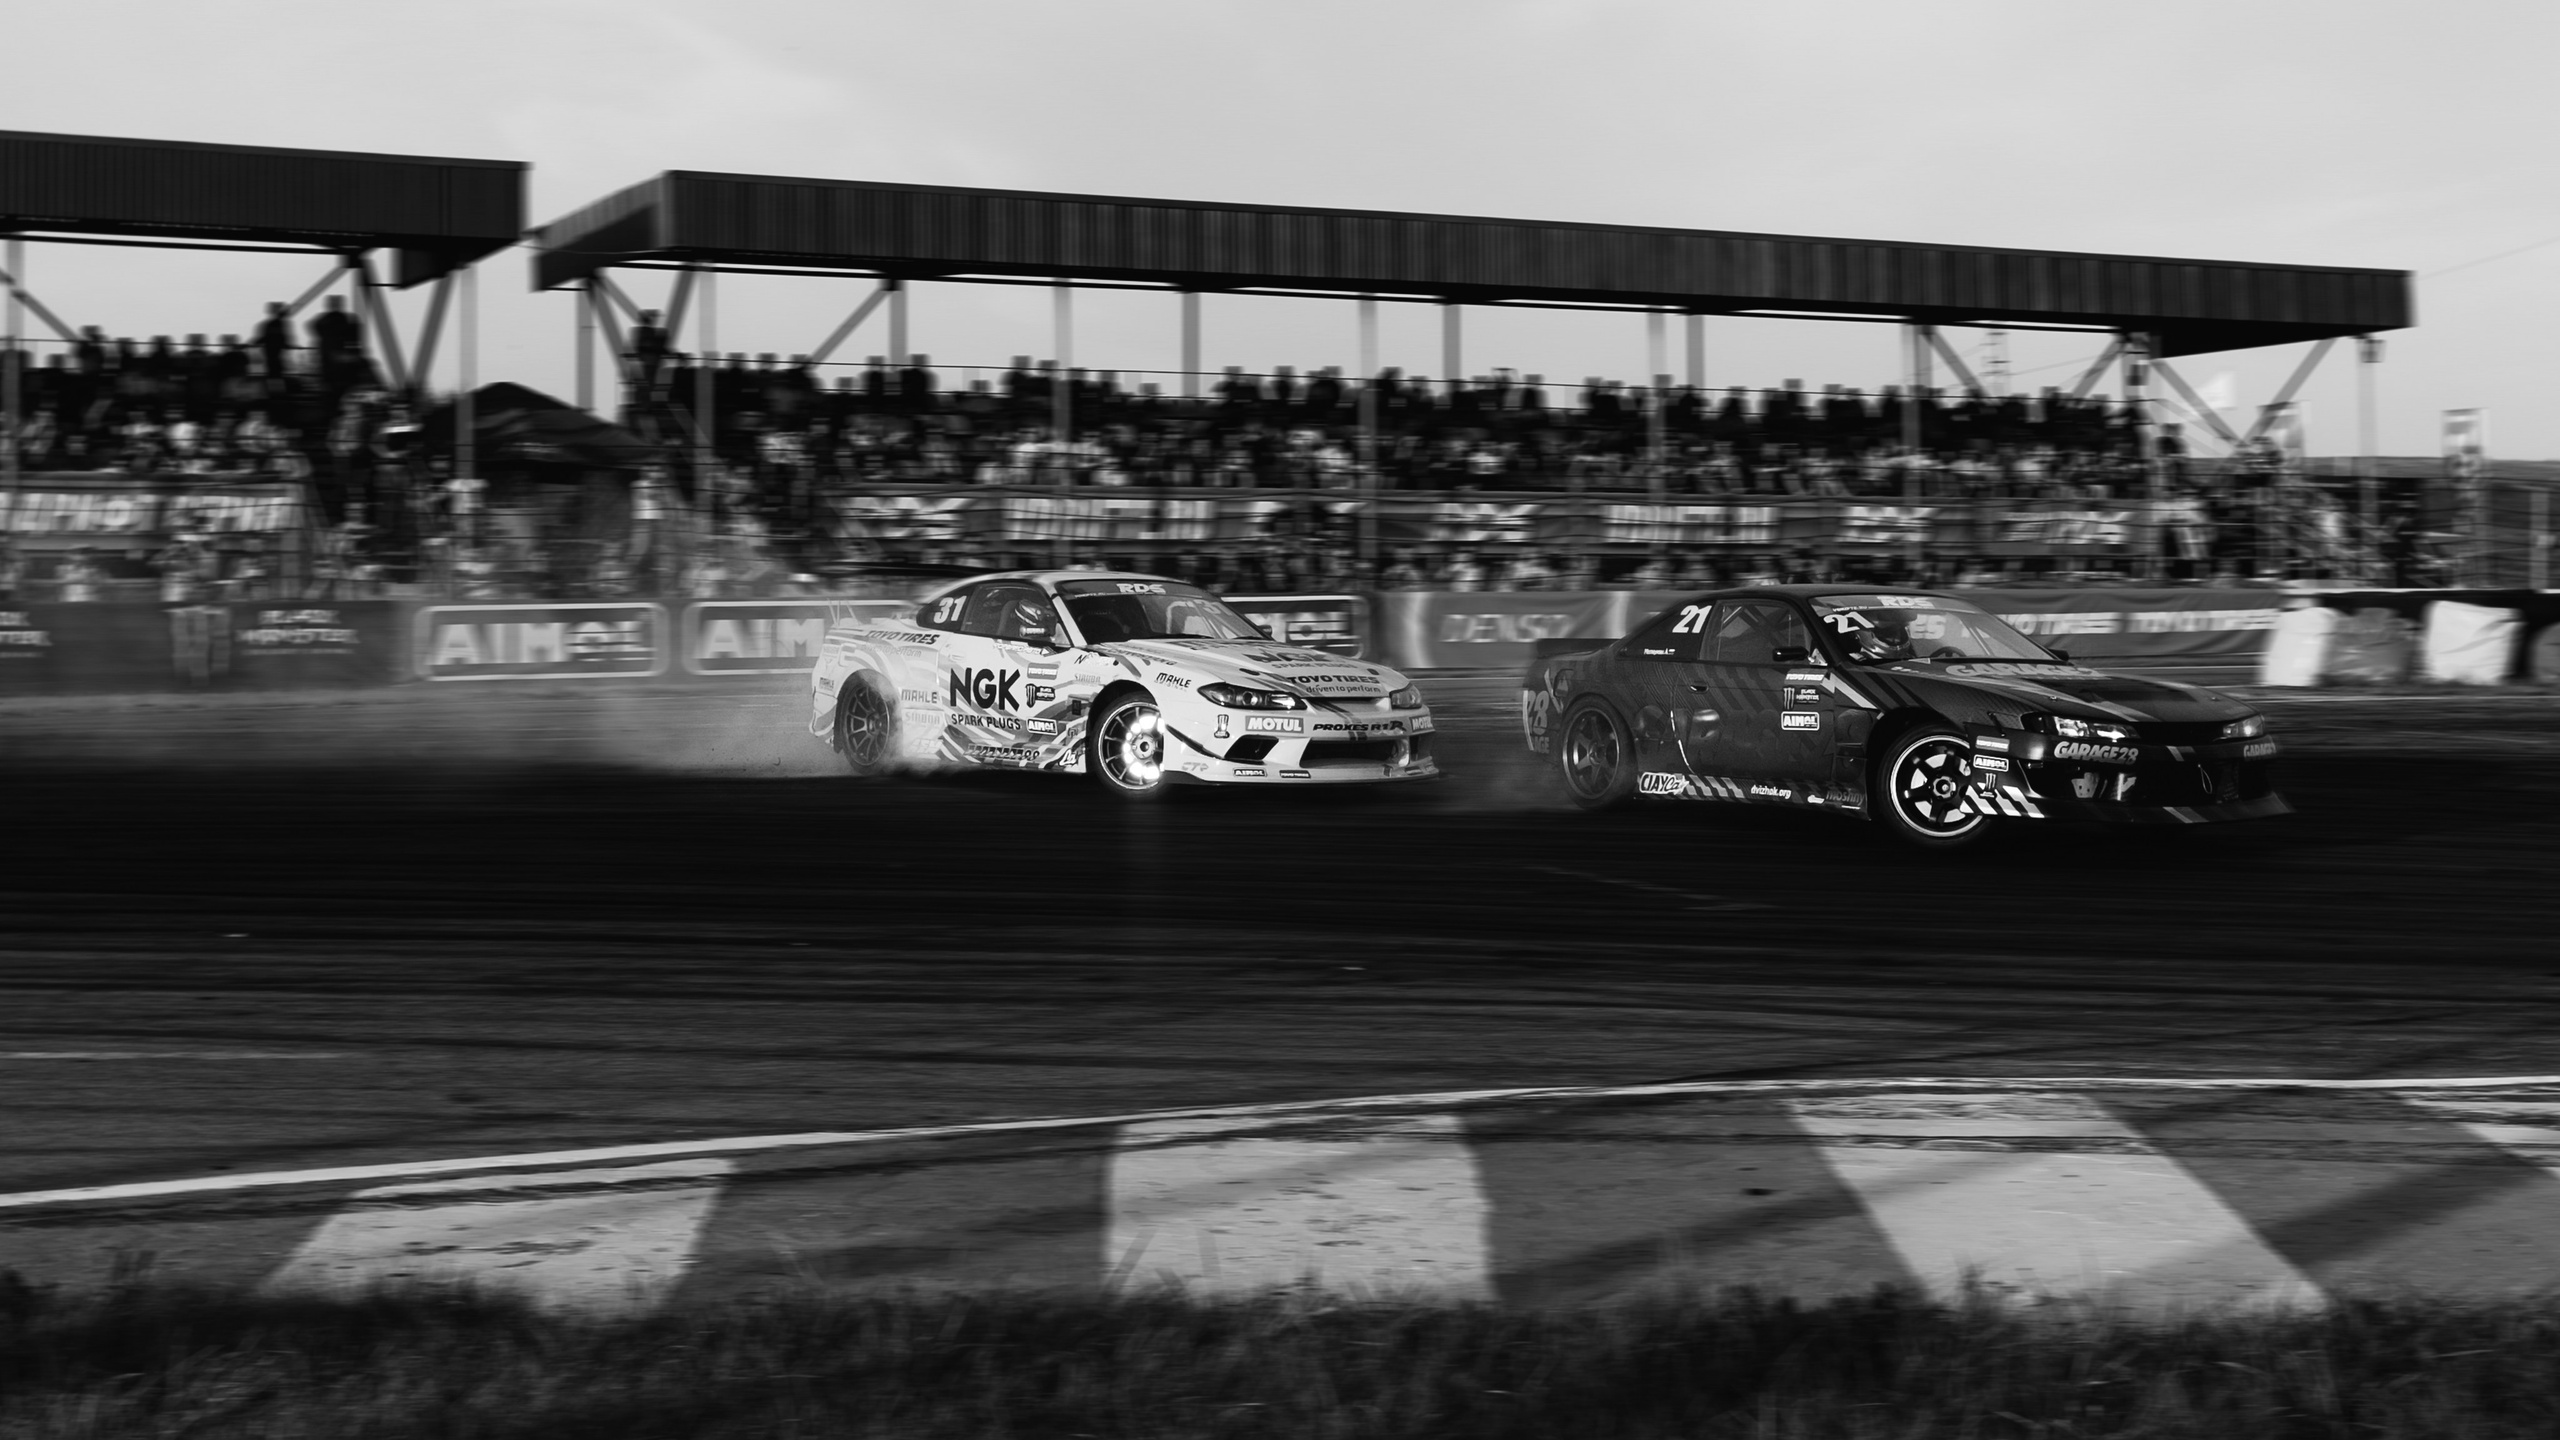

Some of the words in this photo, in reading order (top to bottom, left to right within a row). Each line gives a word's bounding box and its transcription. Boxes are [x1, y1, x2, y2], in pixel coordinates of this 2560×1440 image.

[1116, 583, 1167, 594] RDS
[933, 595, 967, 624] 31
[1876, 596, 1935, 608] RDS
[1673, 606, 1713, 633] 21
[1823, 611, 1875, 633] 21
[866, 630, 902, 641] TOYO
[901, 633, 940, 645] TIRES
[1157, 672, 1192, 688] MAHLE
[1286, 674, 1333, 684] TOYO
[1333, 674, 1380, 684] TIRES
[951, 667, 1021, 711] NGK
[1306, 684, 1335, 693] driven
[1336, 684, 1346, 693] to
[1347, 685, 1381, 693] perform
[901, 689, 938, 704] MAHLE
[951, 713, 984, 727] SPARK
[986, 715, 1021, 731] PLUGS
[1247, 717, 1302, 732] MOTUL
[1371, 720, 1407, 732] R1R
[1783, 715, 1818, 728] AIMOL
[2054, 741, 2139, 764] GARAGE28
